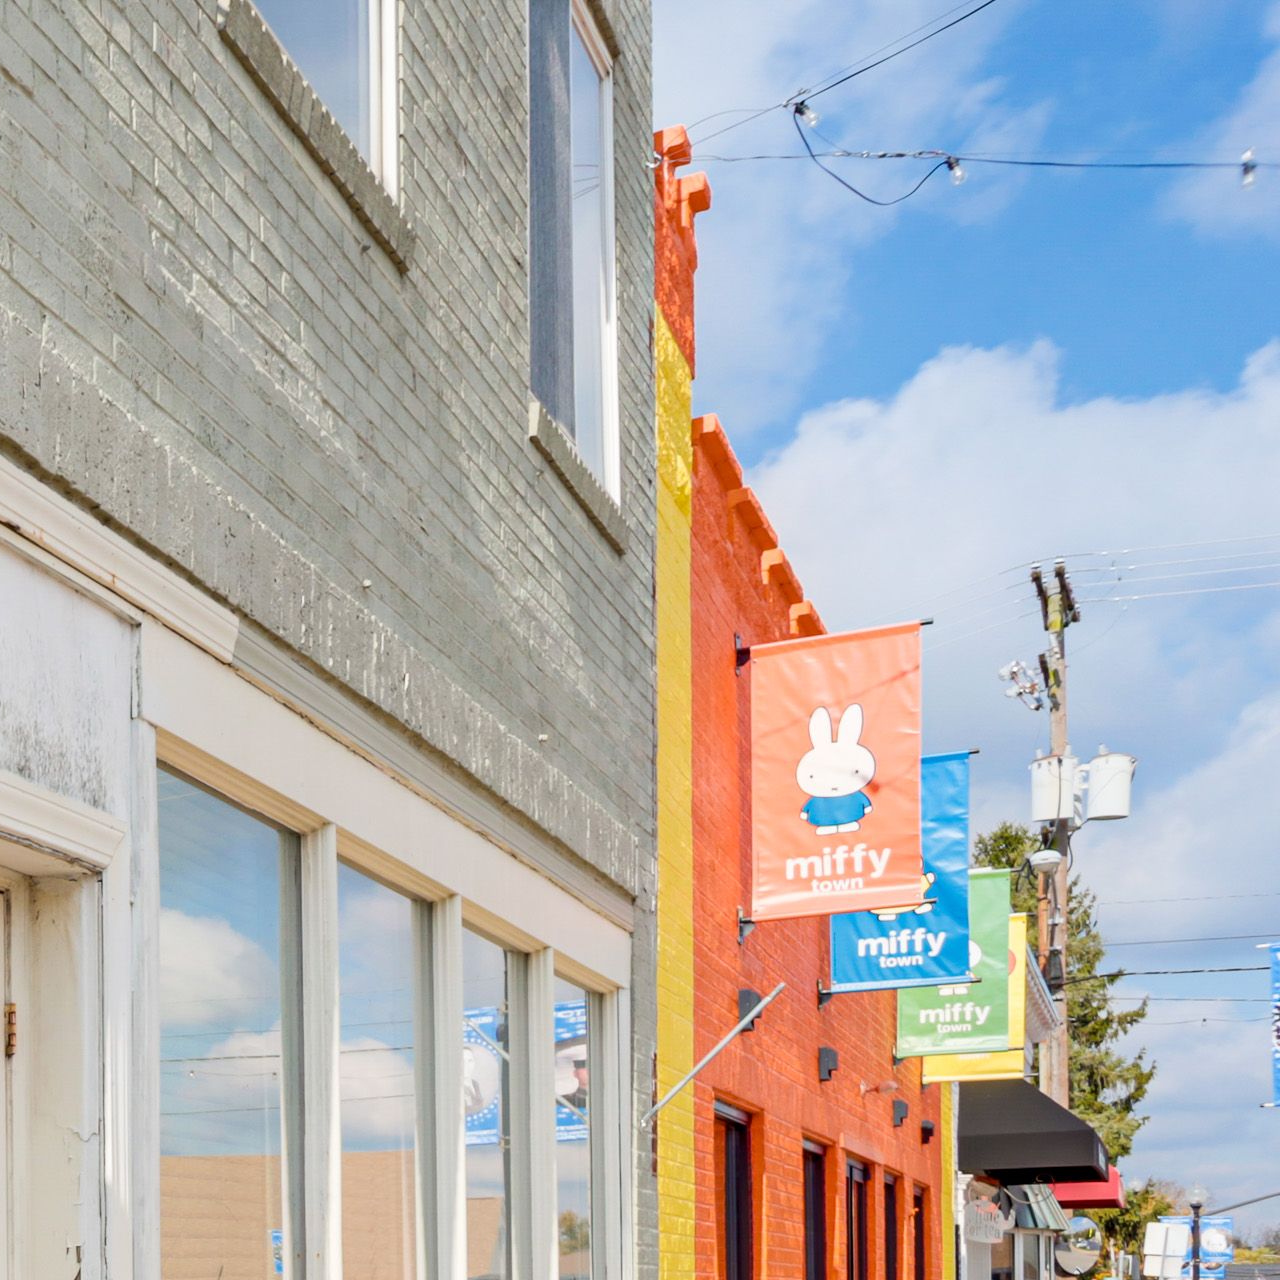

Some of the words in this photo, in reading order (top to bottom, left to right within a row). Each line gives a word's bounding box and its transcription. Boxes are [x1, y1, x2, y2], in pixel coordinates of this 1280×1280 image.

[785, 843, 892, 880] miffy
[811, 877, 864, 895] town
[857, 927, 947, 957] miffy
[879, 955, 923, 968] town
[919, 1001, 992, 1025] miffy
[937, 1023, 972, 1034] town
